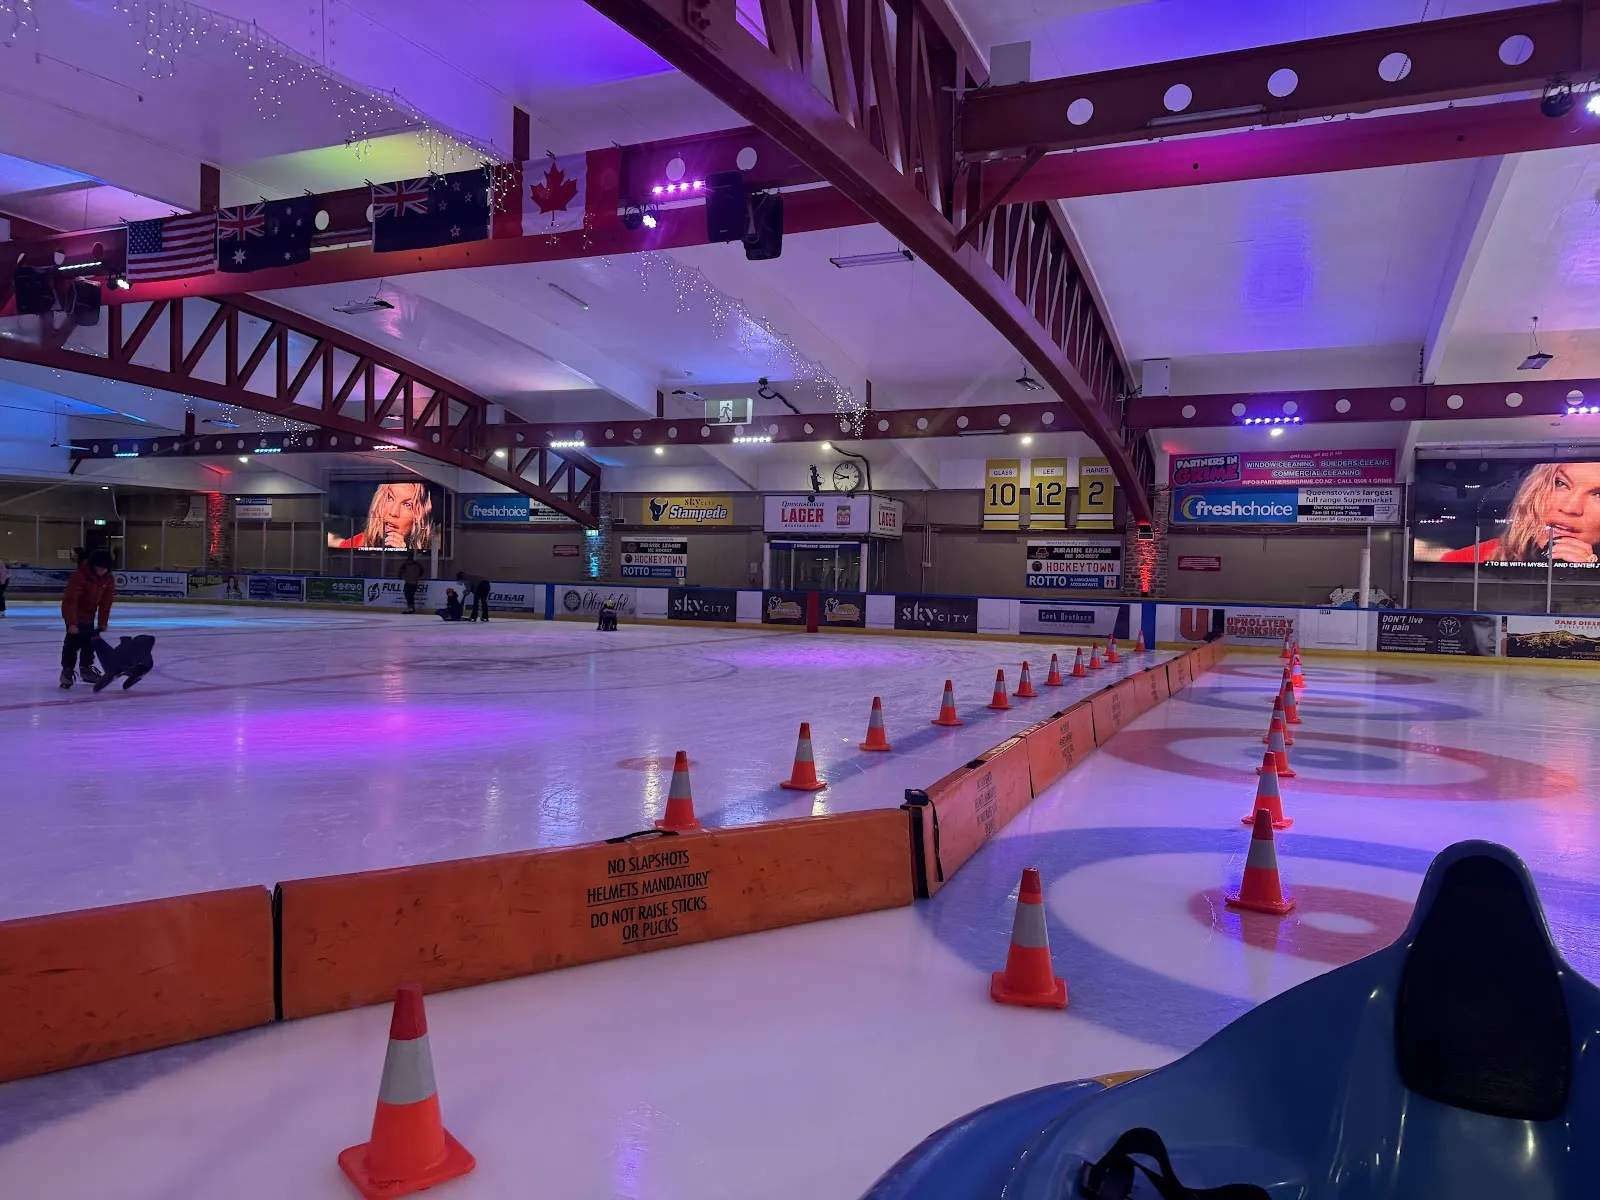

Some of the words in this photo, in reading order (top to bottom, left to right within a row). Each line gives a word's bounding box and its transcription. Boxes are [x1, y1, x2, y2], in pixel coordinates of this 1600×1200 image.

[1177, 457, 1225, 469] PARTNERS
[1227, 455, 1238, 465] IN
[1246, 461, 1276, 469] WINDOW
[1175, 464, 1239, 485] GRIME
[989, 483, 1016, 506] 10
[1035, 482, 1062, 506] 12
[1088, 481, 1104, 505] 2
[1362, 489, 1393, 497] largest
[472, 505, 527, 517] freshchoice
[669, 505, 728, 522] Stampede
[1196, 501, 1293, 516] freshchoice
[781, 509, 824, 522] LAGER
[879, 511, 896, 527] LAGER
[634, 555, 683, 564] HOCKEYTOWN
[623, 567, 649, 575] ROTTO
[1047, 563, 1114, 572] HOCKEYTOWN
[153, 576, 183, 584] CHILL
[1029, 576, 1066, 586] ROTTO
[277, 582, 299, 592] Colliers
[383, 583, 401, 592] FULL
[488, 592, 524, 602] COUGAR
[1061, 613, 1092, 621] Brothers
[1226, 617, 1294, 628] UPHOLSTERY
[1382, 615, 1407, 623] DON'T
[1408, 616, 1423, 624] live
[1226, 626, 1294, 636] WORKSHOP
[1382, 623, 1390, 631] in
[1391, 624, 1410, 632] pain
[608, 859, 625, 874] NO
[629, 850, 689, 871] SLAPSHOTS
[587, 882, 639, 903] HELMETS
[642, 871, 709, 895] MANDATORY
[591, 912, 608, 928] DO
[612, 907, 635, 925] NOT
[639, 901, 668, 921] RAISE
[672, 896, 707, 914] STICKS
[623, 924, 638, 940] OR
[643, 917, 678, 936] PUCKS
